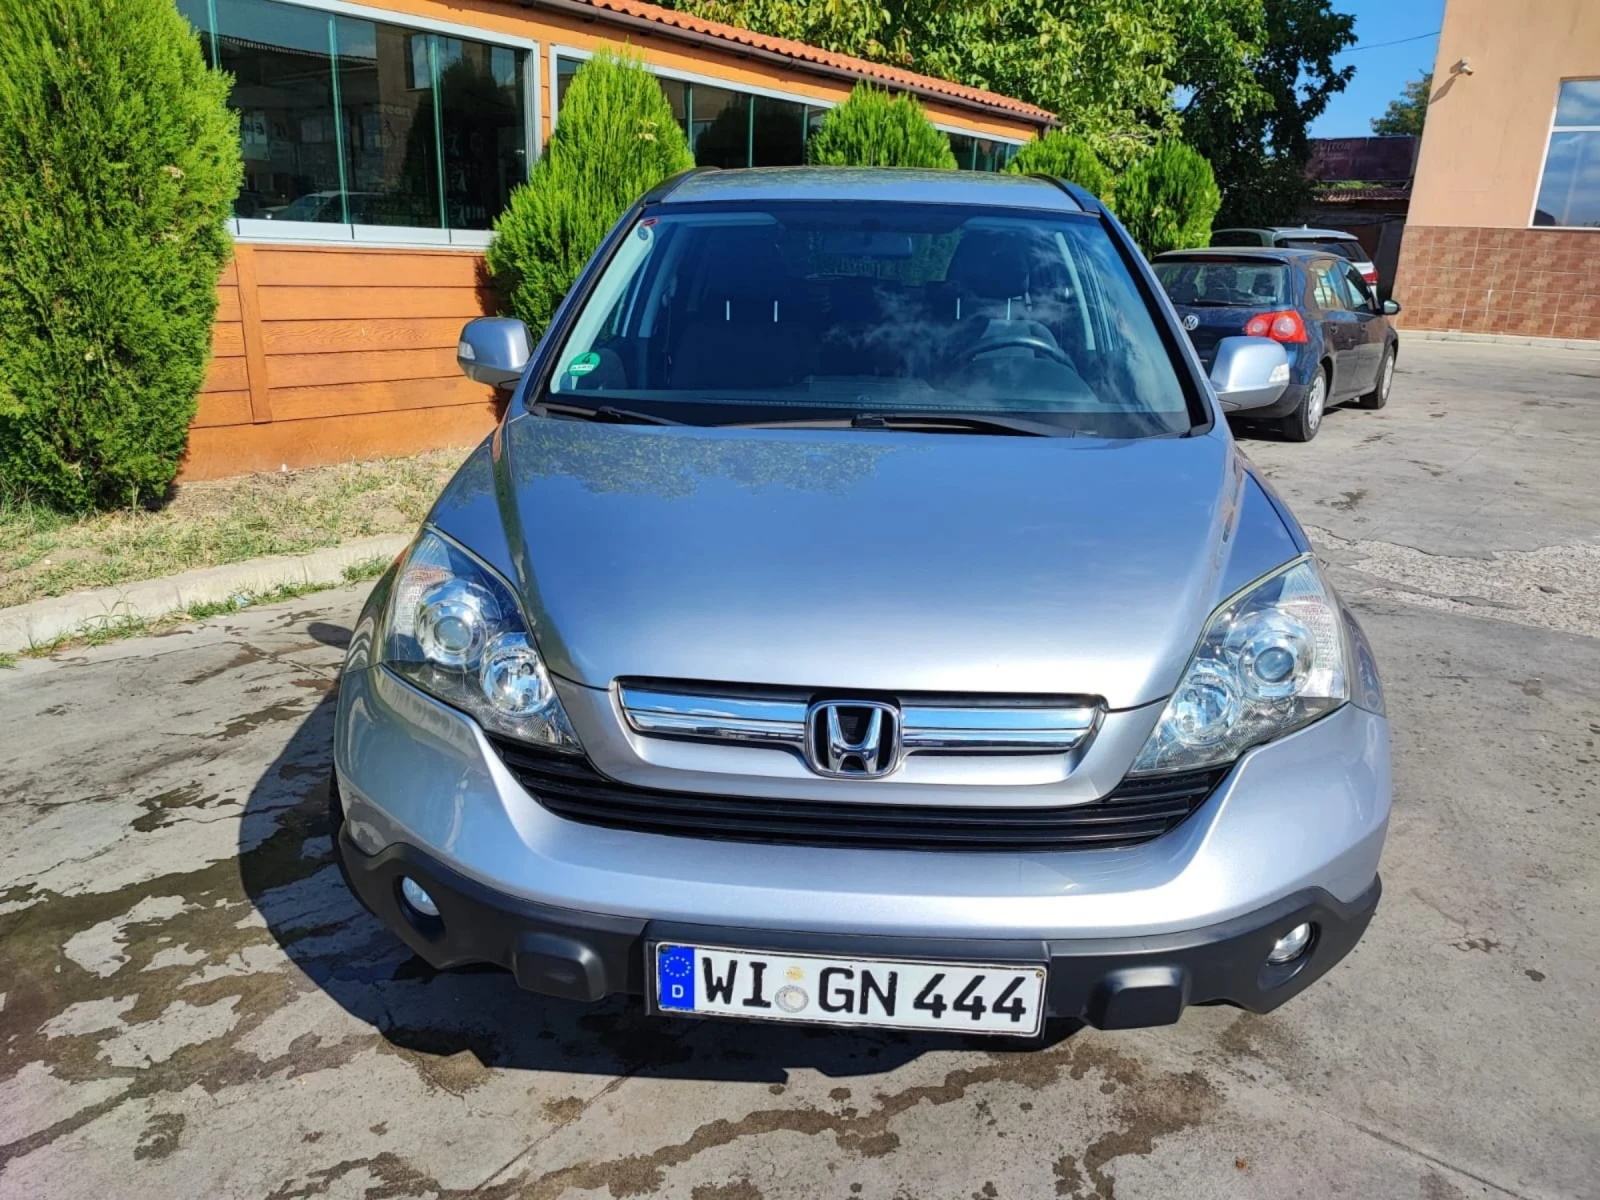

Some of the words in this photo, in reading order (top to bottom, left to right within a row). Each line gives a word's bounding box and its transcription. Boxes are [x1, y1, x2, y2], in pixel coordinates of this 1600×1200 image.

[672, 984, 684, 998] D
[702, 957, 771, 1008] WI
[818, 967, 898, 1016] GN
[913, 973, 1026, 1022] 444
